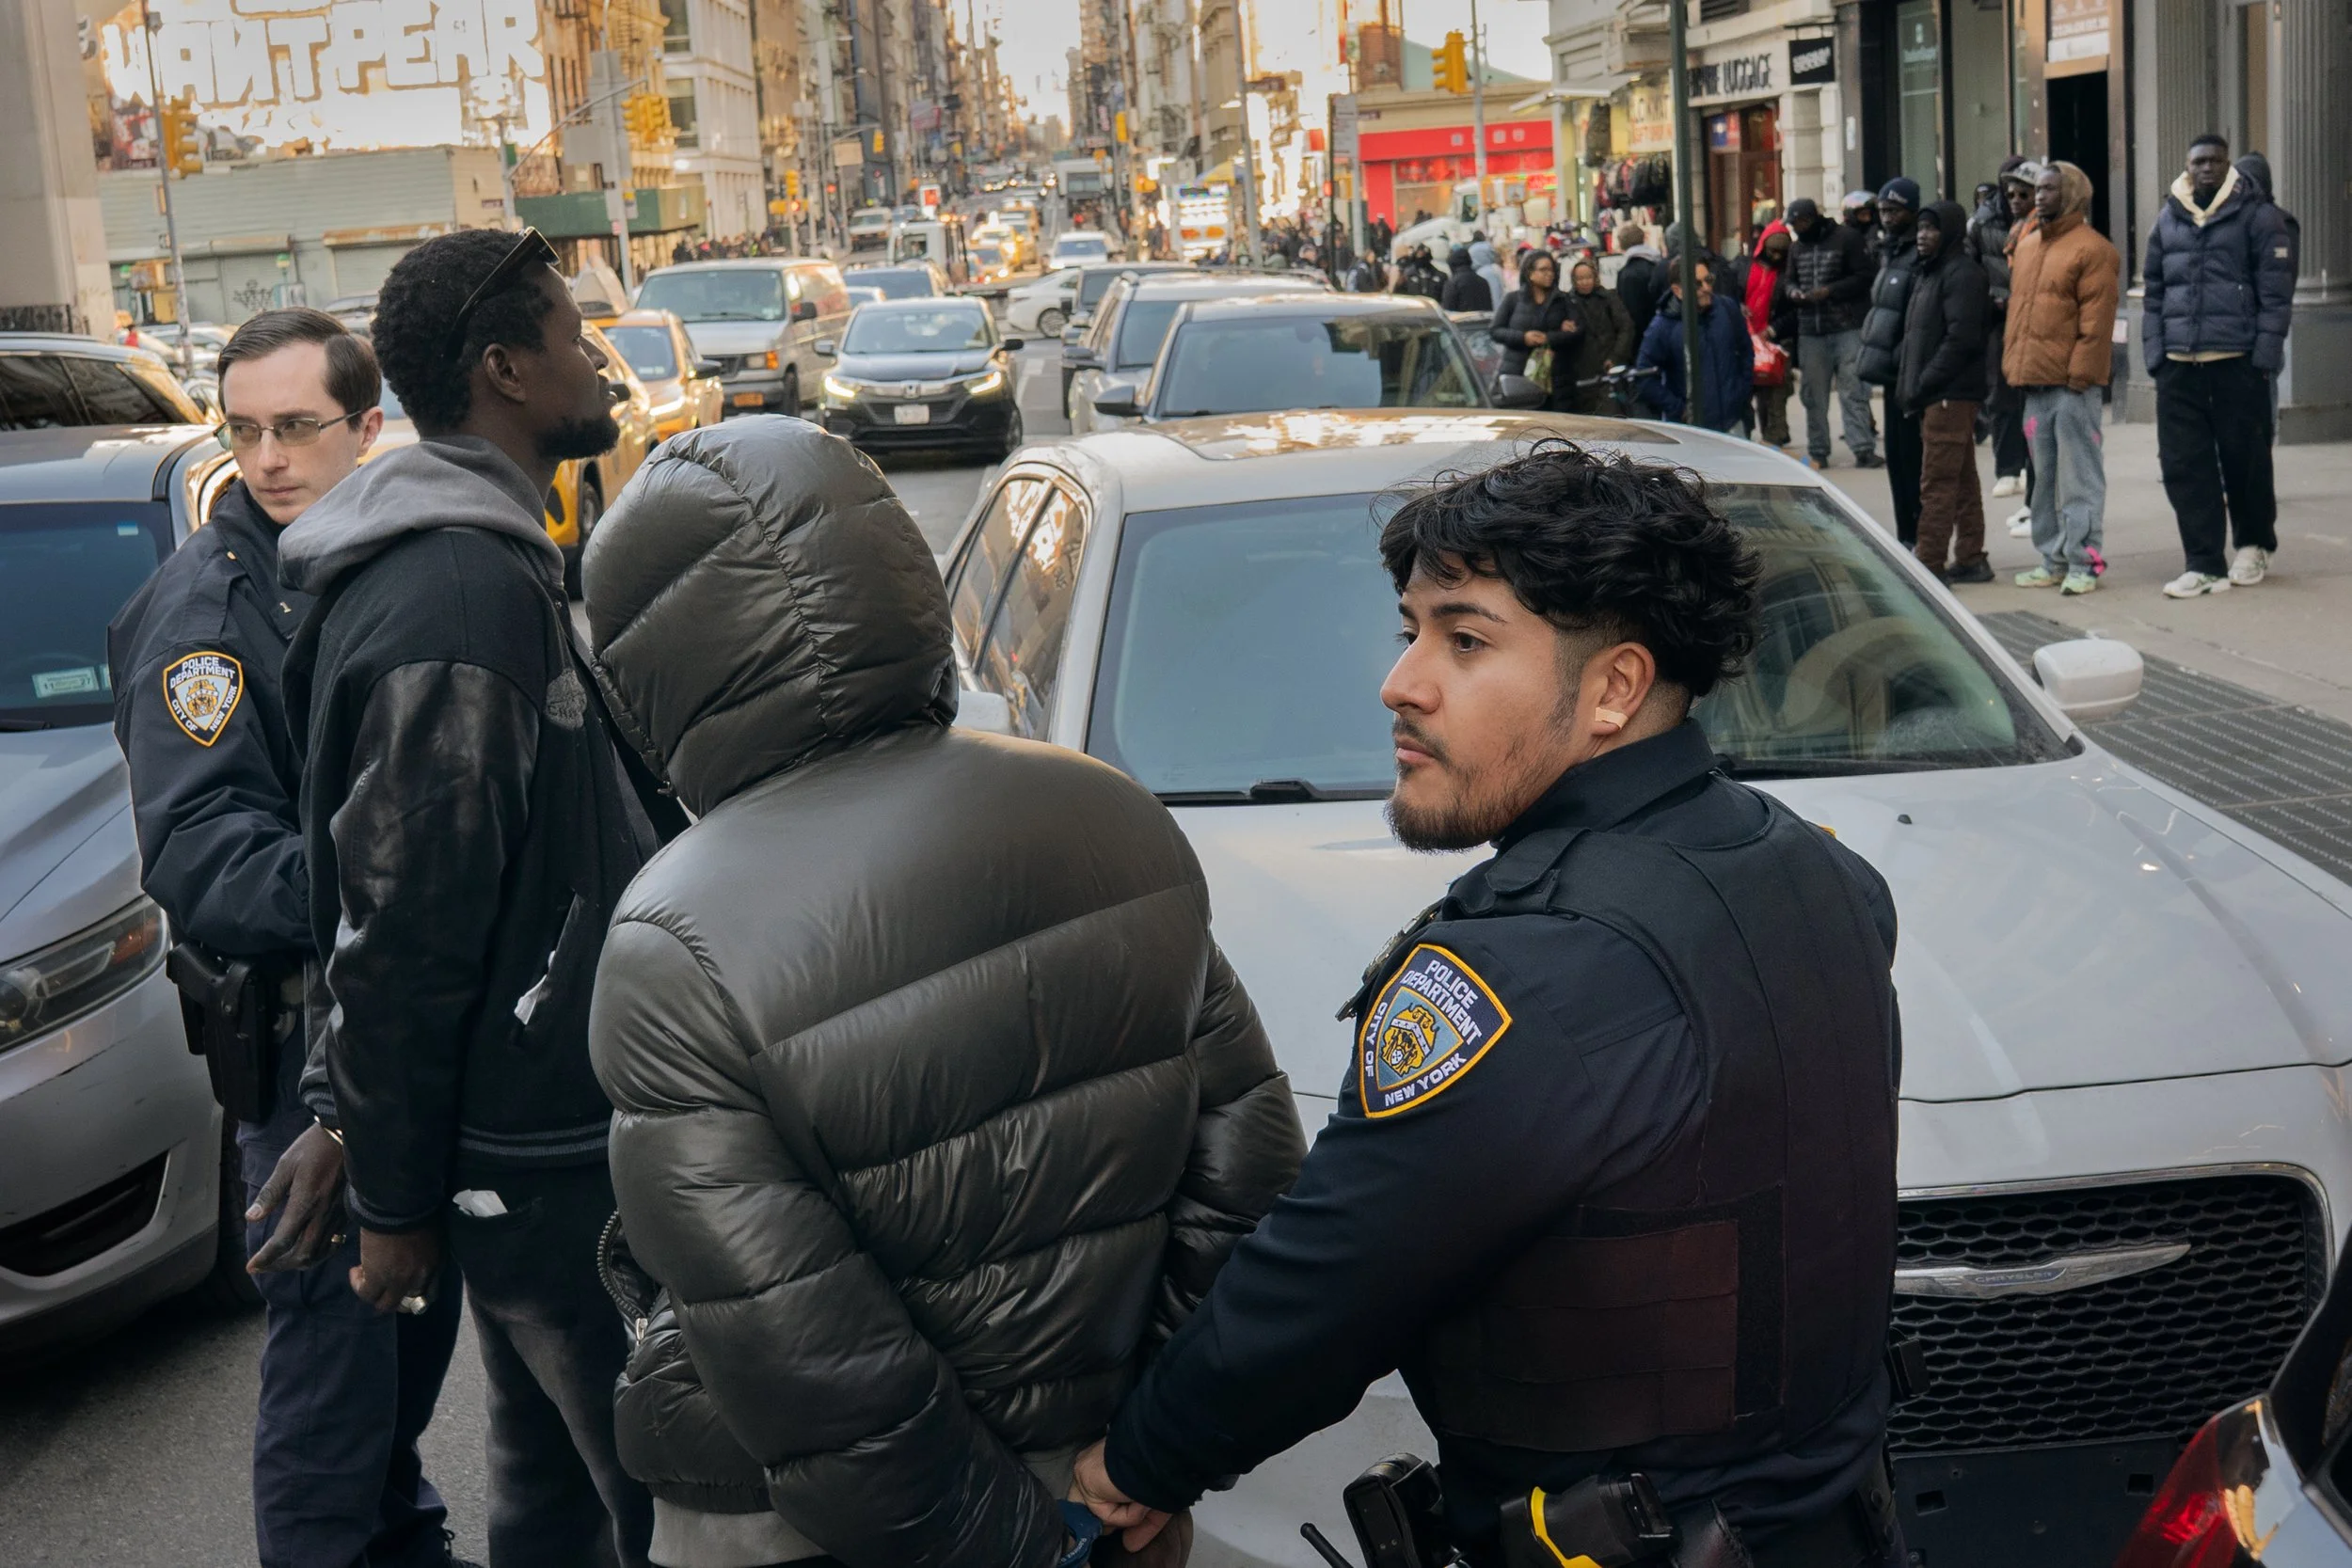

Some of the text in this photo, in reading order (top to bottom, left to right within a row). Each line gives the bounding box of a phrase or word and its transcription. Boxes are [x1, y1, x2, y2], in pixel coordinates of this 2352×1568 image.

[1724, 53, 1772, 96] LUGGAGE
[170, 666, 235, 689] DEPARTMENT
[182, 657, 219, 672] POLICE
[171, 699, 199, 732] CITY OF
[209, 685, 237, 732] NEW YORK
[1424, 959, 1479, 1009] POLICE
[1400, 970, 1482, 1046] DEPARTMENT
[1365, 1001, 1388, 1077] CITY OF
[1384, 1052, 1468, 1107] NEW YORK
[1975, 1272, 2052, 1283] CHRYSLER
